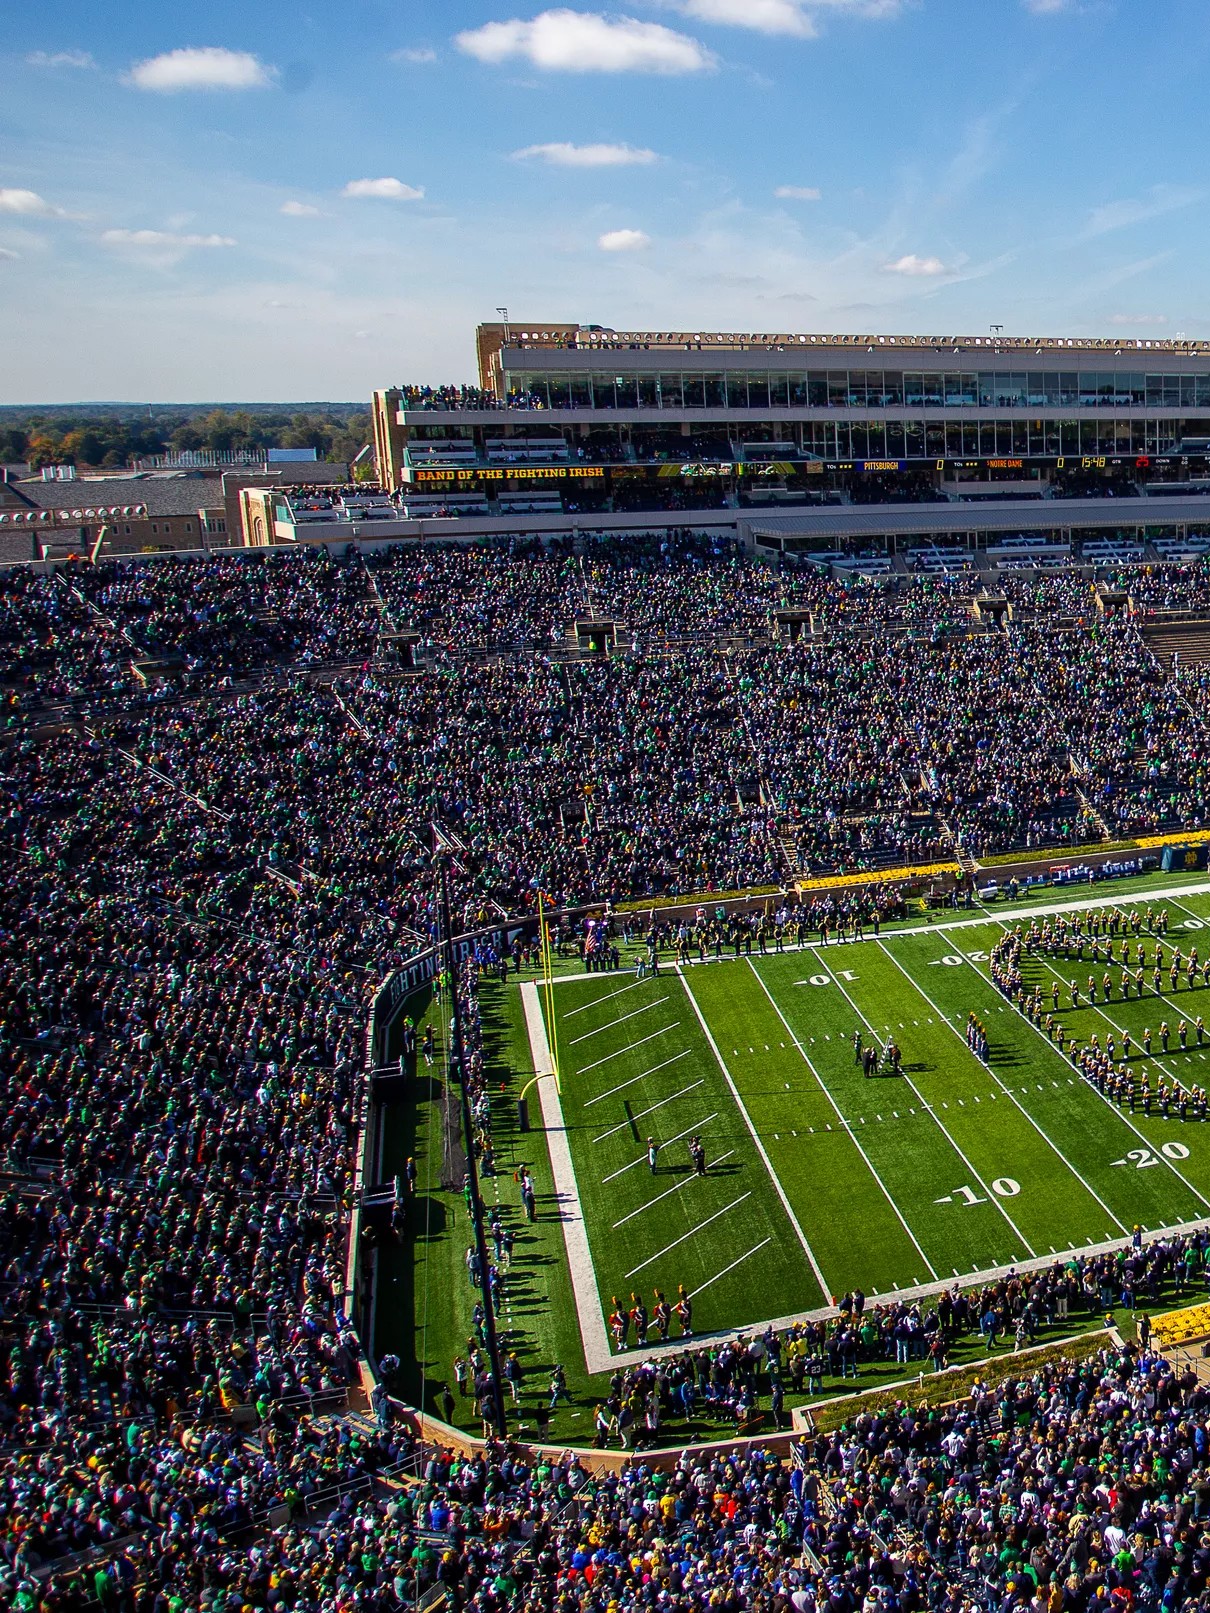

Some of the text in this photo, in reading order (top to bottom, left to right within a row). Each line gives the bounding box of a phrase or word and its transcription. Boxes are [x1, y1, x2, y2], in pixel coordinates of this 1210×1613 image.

[863, 461, 899, 470] PITTSBURGH
[936, 459, 944, 470] 0
[989, 460, 1007, 468] NOTRE
[1007, 459, 1023, 468] DAME
[1057, 457, 1064, 468] 0
[1081, 457, 1106, 468] 15:48
[416, 470, 455, 480] BAND
[457, 470, 473, 480] OF
[477, 469, 503, 479] THE
[505, 468, 567, 478] FIGHTING
[569, 467, 604, 477] IRISH
[942, 950, 990, 966] 20
[1127, 1142, 1190, 1169] 20
[951, 1177, 1021, 1206] 10
[811, 1365, 820, 1374] 23
